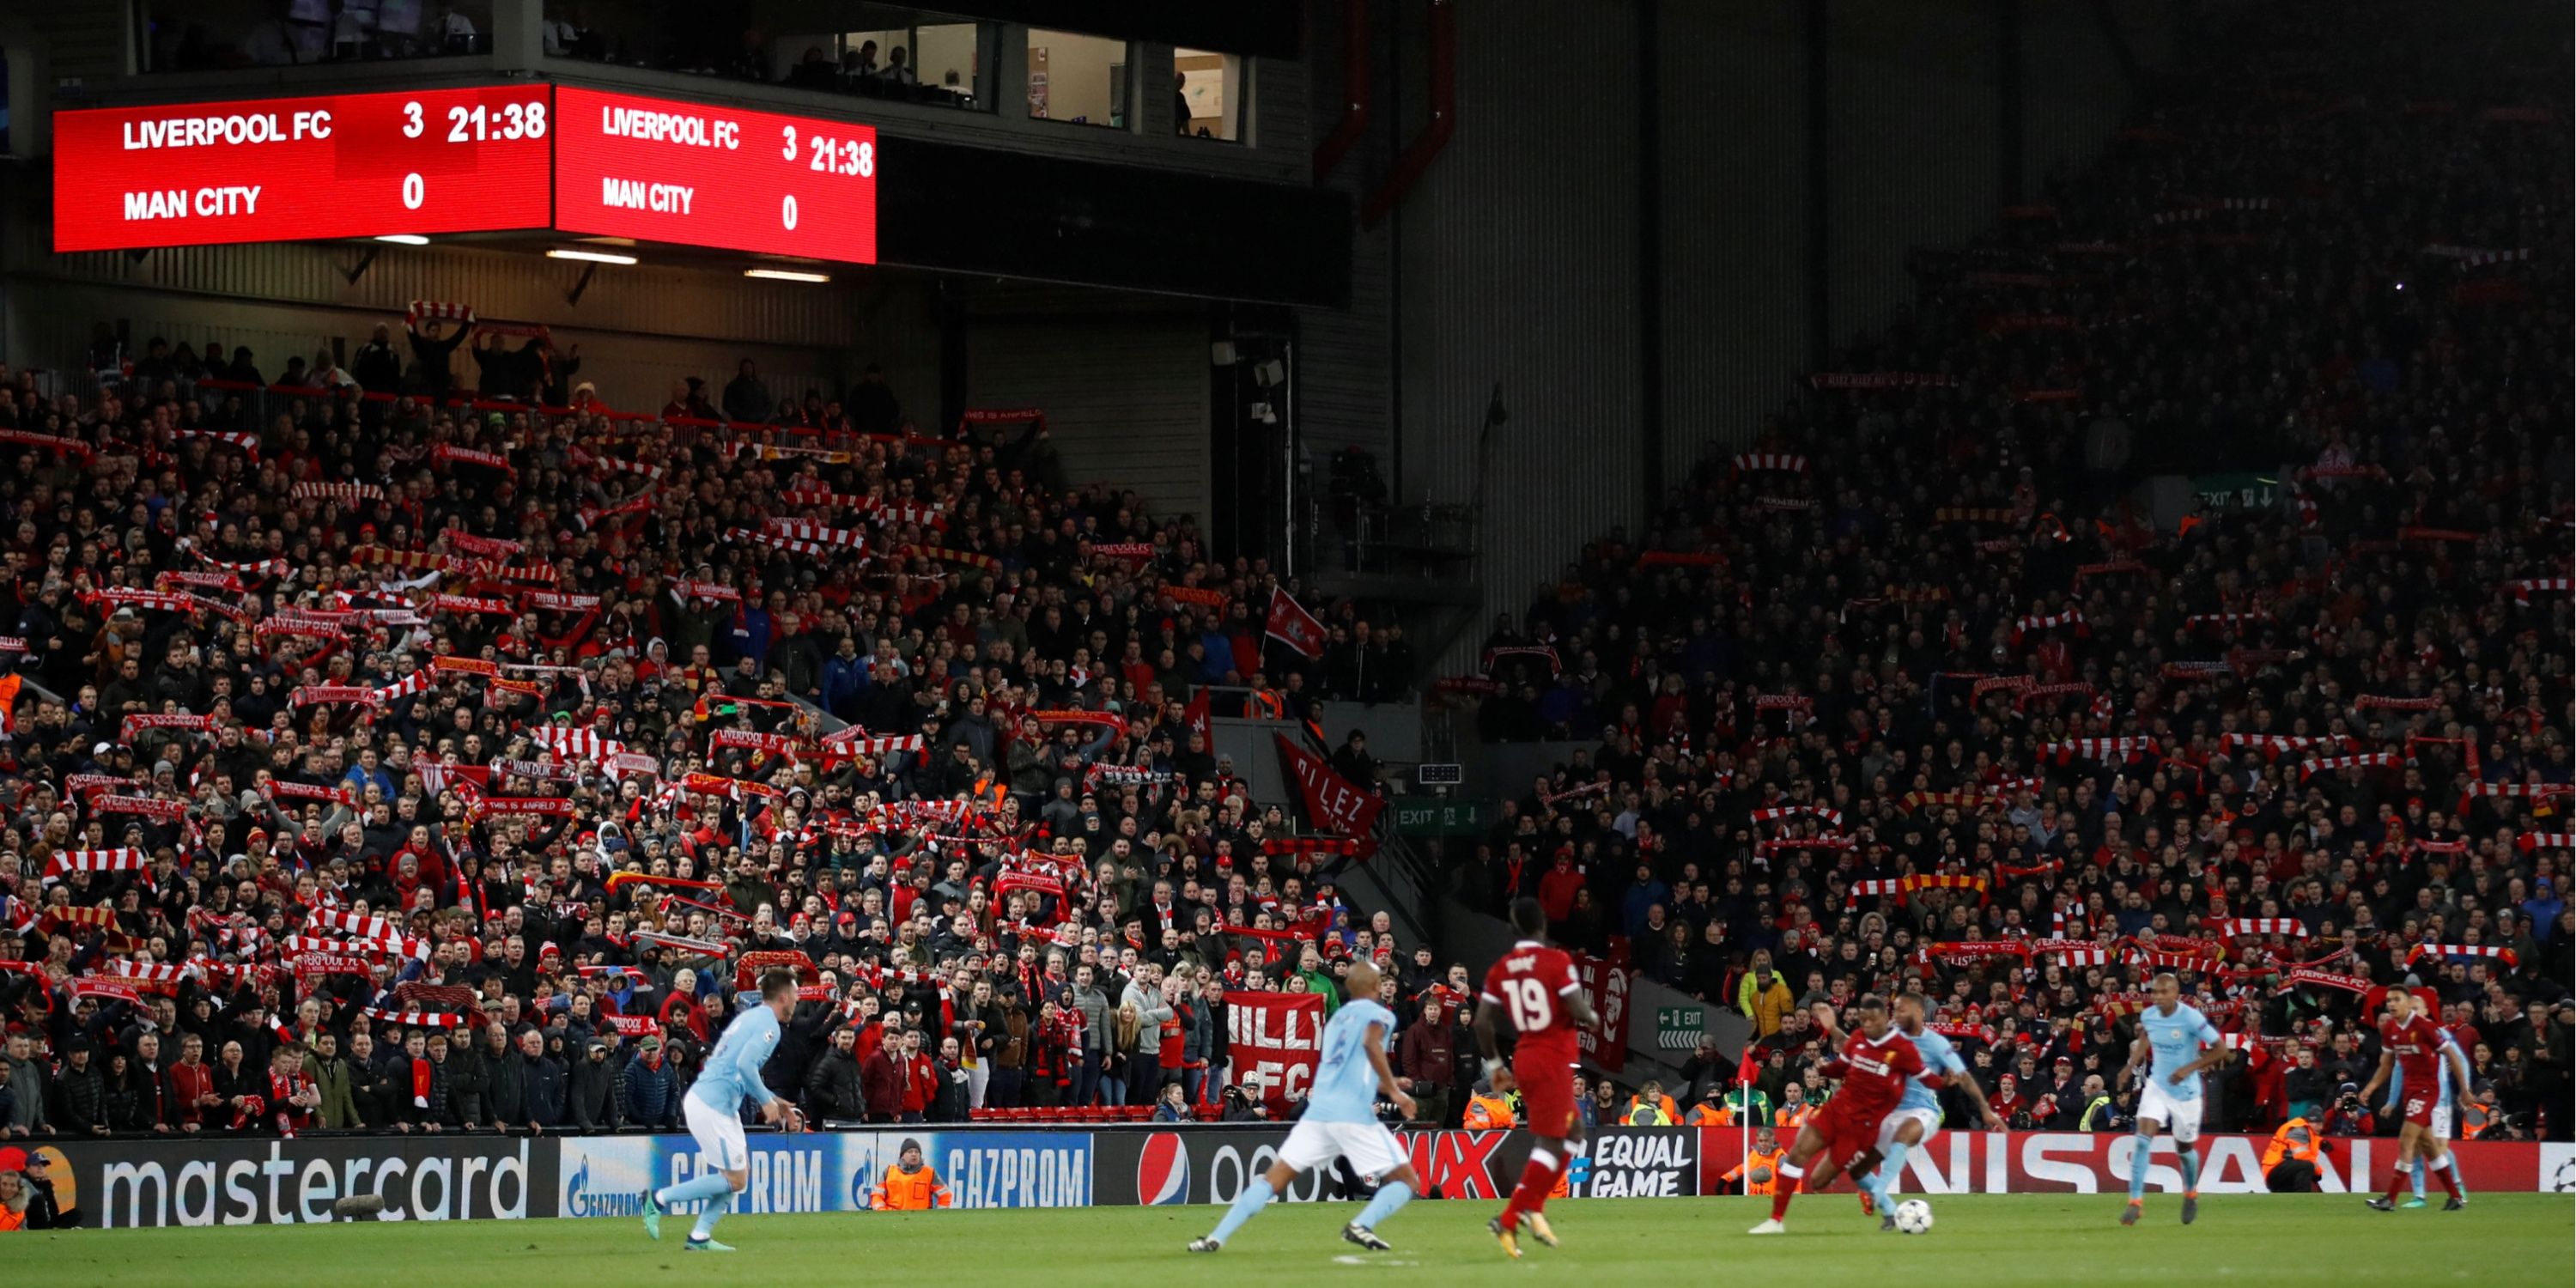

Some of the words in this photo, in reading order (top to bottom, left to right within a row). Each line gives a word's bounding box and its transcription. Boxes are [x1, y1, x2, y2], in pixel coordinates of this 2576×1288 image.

[124, 113, 286, 150] LIVERPOOL
[293, 110, 331, 141] FC
[403, 101, 424, 138] 3
[447, 102, 546, 143] 21:38
[603, 106, 710, 147] LIVERPOOL
[714, 120, 739, 150] FC
[782, 125, 797, 161] 3
[811, 136, 873, 177] 21:38
[124, 190, 187, 221] MAN
[195, 185, 261, 216] CITY
[403, 173, 424, 210] 0
[603, 177, 645, 210] MAN
[649, 183, 694, 215] CITY
[782, 195, 798, 230] 0
[447, 447, 490, 462] LIVERPOOL
[492, 456, 502, 465] FC
[1091, 543, 1136, 552] VERPOOL
[535, 592, 559, 605] STEVEN
[572, 595, 600, 605] GERRARD
[694, 584, 737, 596] LIVERPOOL
[270, 617, 337, 633] LIVERPOOL
[438, 658, 478, 671] LIVERPOOL
[481, 663, 491, 672] FC
[1978, 676, 2021, 690] LIVERPOOL
[317, 689, 361, 699] LIVERPOOL
[1757, 696, 1795, 705] VERPOOL
[720, 729, 763, 744] LIVERPOOL
[769, 734, 779, 745] FC
[513, 759, 532, 775] VAN
[533, 762, 551, 777] DIJK
[753, 783, 767, 793] FC
[164, 801, 177, 811] FC
[490, 800, 507, 810] THIS
[510, 801, 519, 810] IS
[522, 800, 556, 811] ANFIELD
[1400, 810, 1435, 825] EXIT
[2036, 939, 2086, 948] VERPOOL
[2155, 934, 2203, 948] LIVERPOOL
[302, 955, 343, 966] VERPOOL
[2290, 968, 2348, 985] LIVERPOOL
[2349, 977, 2366, 988] FC
[1500, 977, 1552, 1032] 19
[1685, 1012, 1702, 1025] EXIT
[2406, 1099, 2426, 1117] 66
[1593, 1134, 1692, 1170] EQUAL
[1889, 1130, 2371, 1194] NISSAN
[103, 1139, 528, 1229] mastercard
[671, 1149, 822, 1216] GAROM
[951, 1148, 1084, 1210] GAZPROM
[1590, 1170, 1680, 1198] GAME
[589, 1192, 643, 1217] GAZPROM
